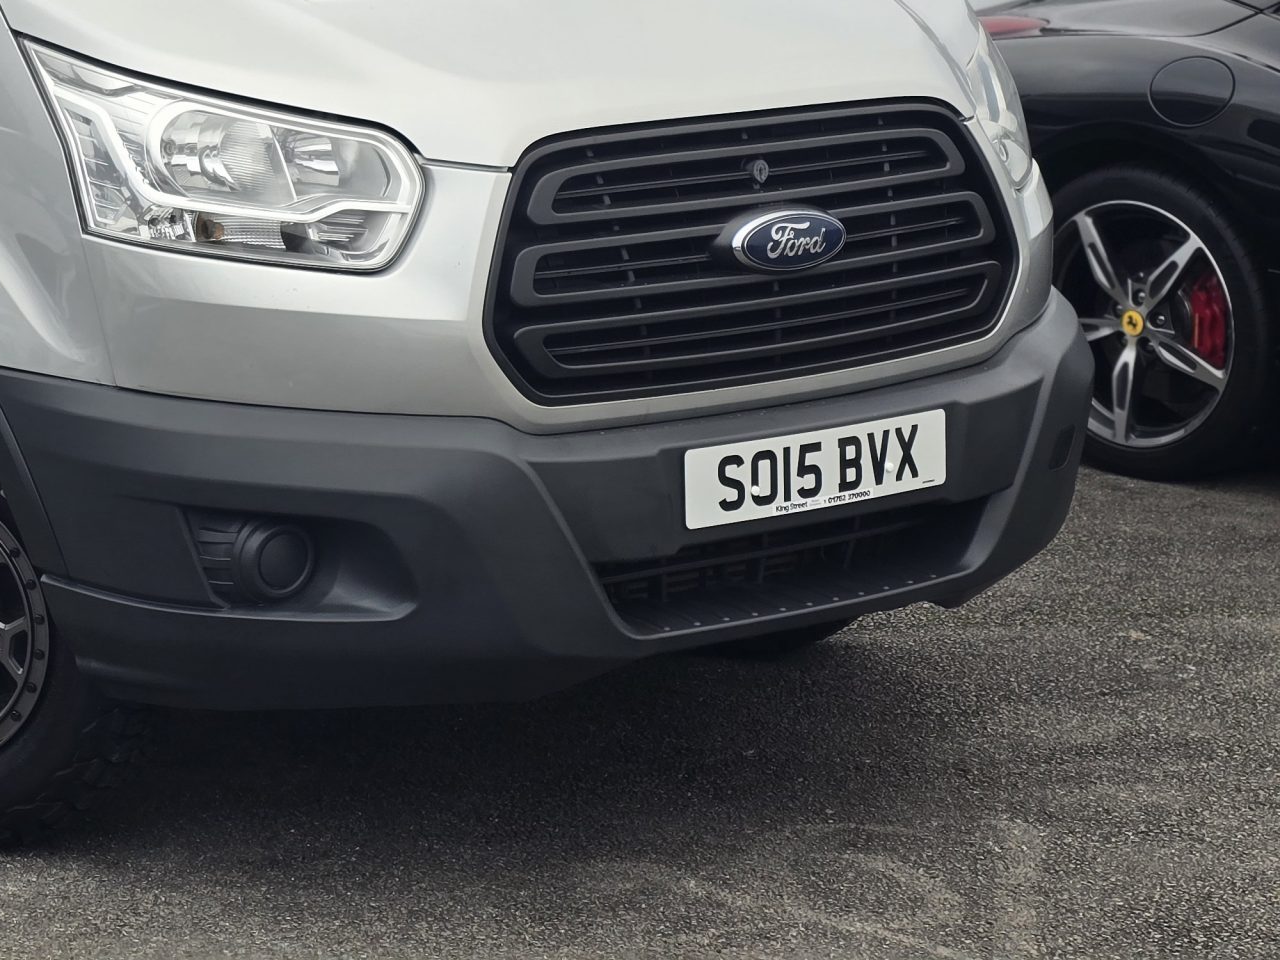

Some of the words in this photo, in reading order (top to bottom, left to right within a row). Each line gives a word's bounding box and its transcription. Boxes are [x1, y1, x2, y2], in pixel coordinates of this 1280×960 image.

[766, 221, 826, 259] Ford
[717, 441, 822, 512] SO15
[838, 424, 919, 493] BVX
[776, 504, 789, 513] King
[790, 501, 808, 510] Street
